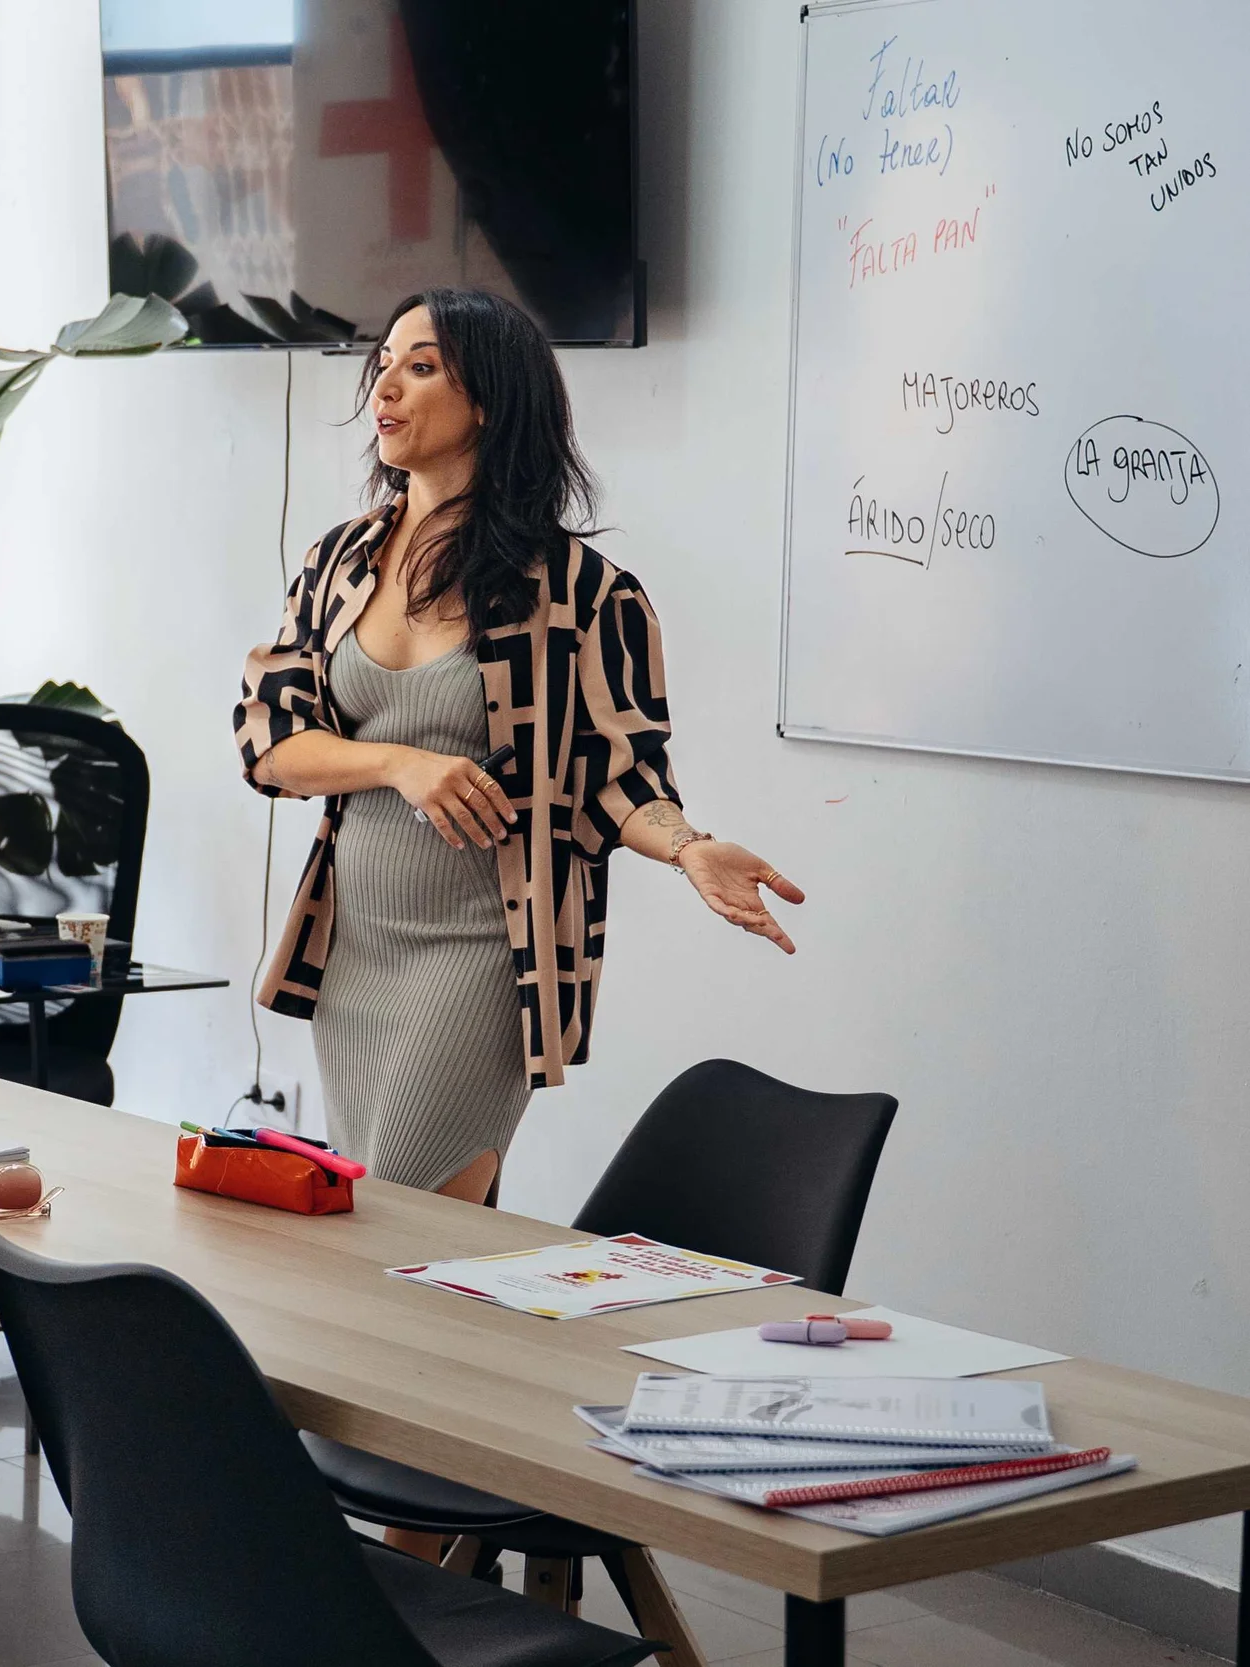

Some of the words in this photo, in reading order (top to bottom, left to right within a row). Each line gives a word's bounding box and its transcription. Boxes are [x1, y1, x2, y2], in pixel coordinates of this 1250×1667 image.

[1065, 126, 1093, 167] NO
[1102, 100, 1164, 152] SOMOS
[1128, 137, 1168, 177] TAN
[1150, 152, 1217, 212] UNIDOS
[1077, 438, 1101, 477] LA
